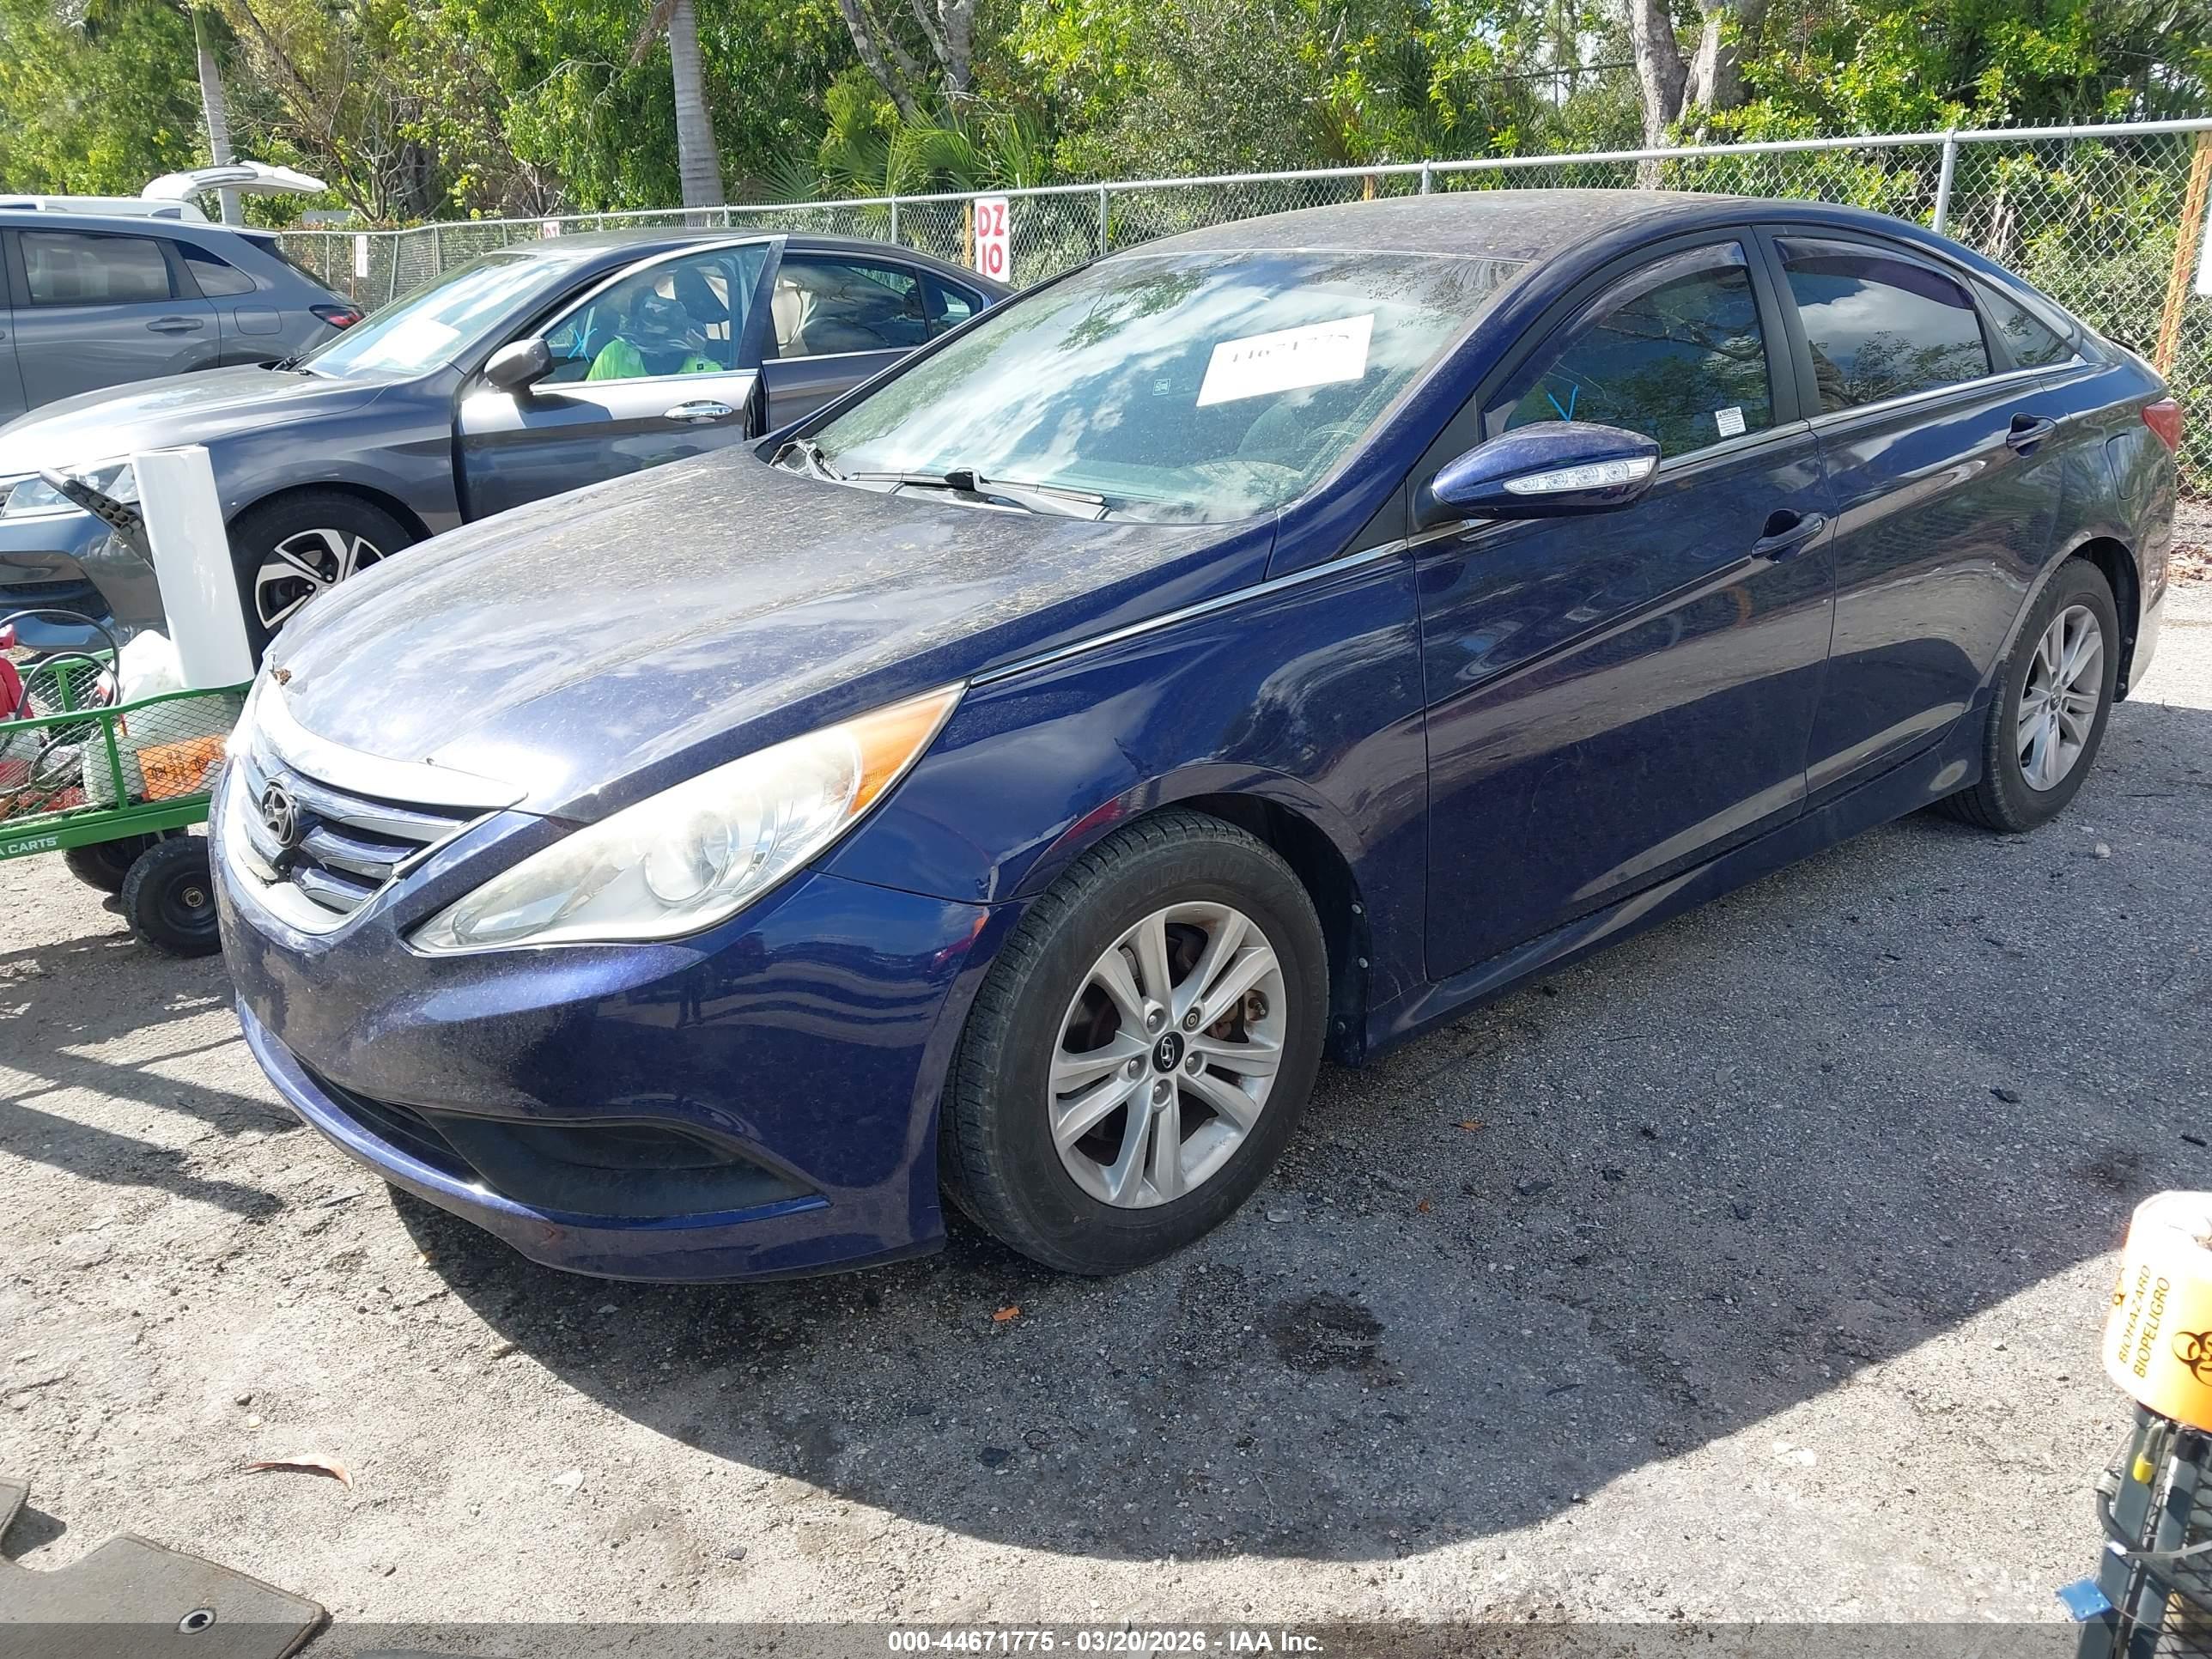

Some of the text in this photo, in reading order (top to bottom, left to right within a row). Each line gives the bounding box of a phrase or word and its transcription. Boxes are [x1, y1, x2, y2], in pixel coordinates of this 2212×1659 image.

[977, 204, 1005, 238] DZ
[981, 243, 1003, 276] 10
[8, 836, 58, 854] CARTS
[2118, 1264, 2151, 1364] BIOHAZARD
[2133, 1277, 2170, 1378] BIOPELIGRO
